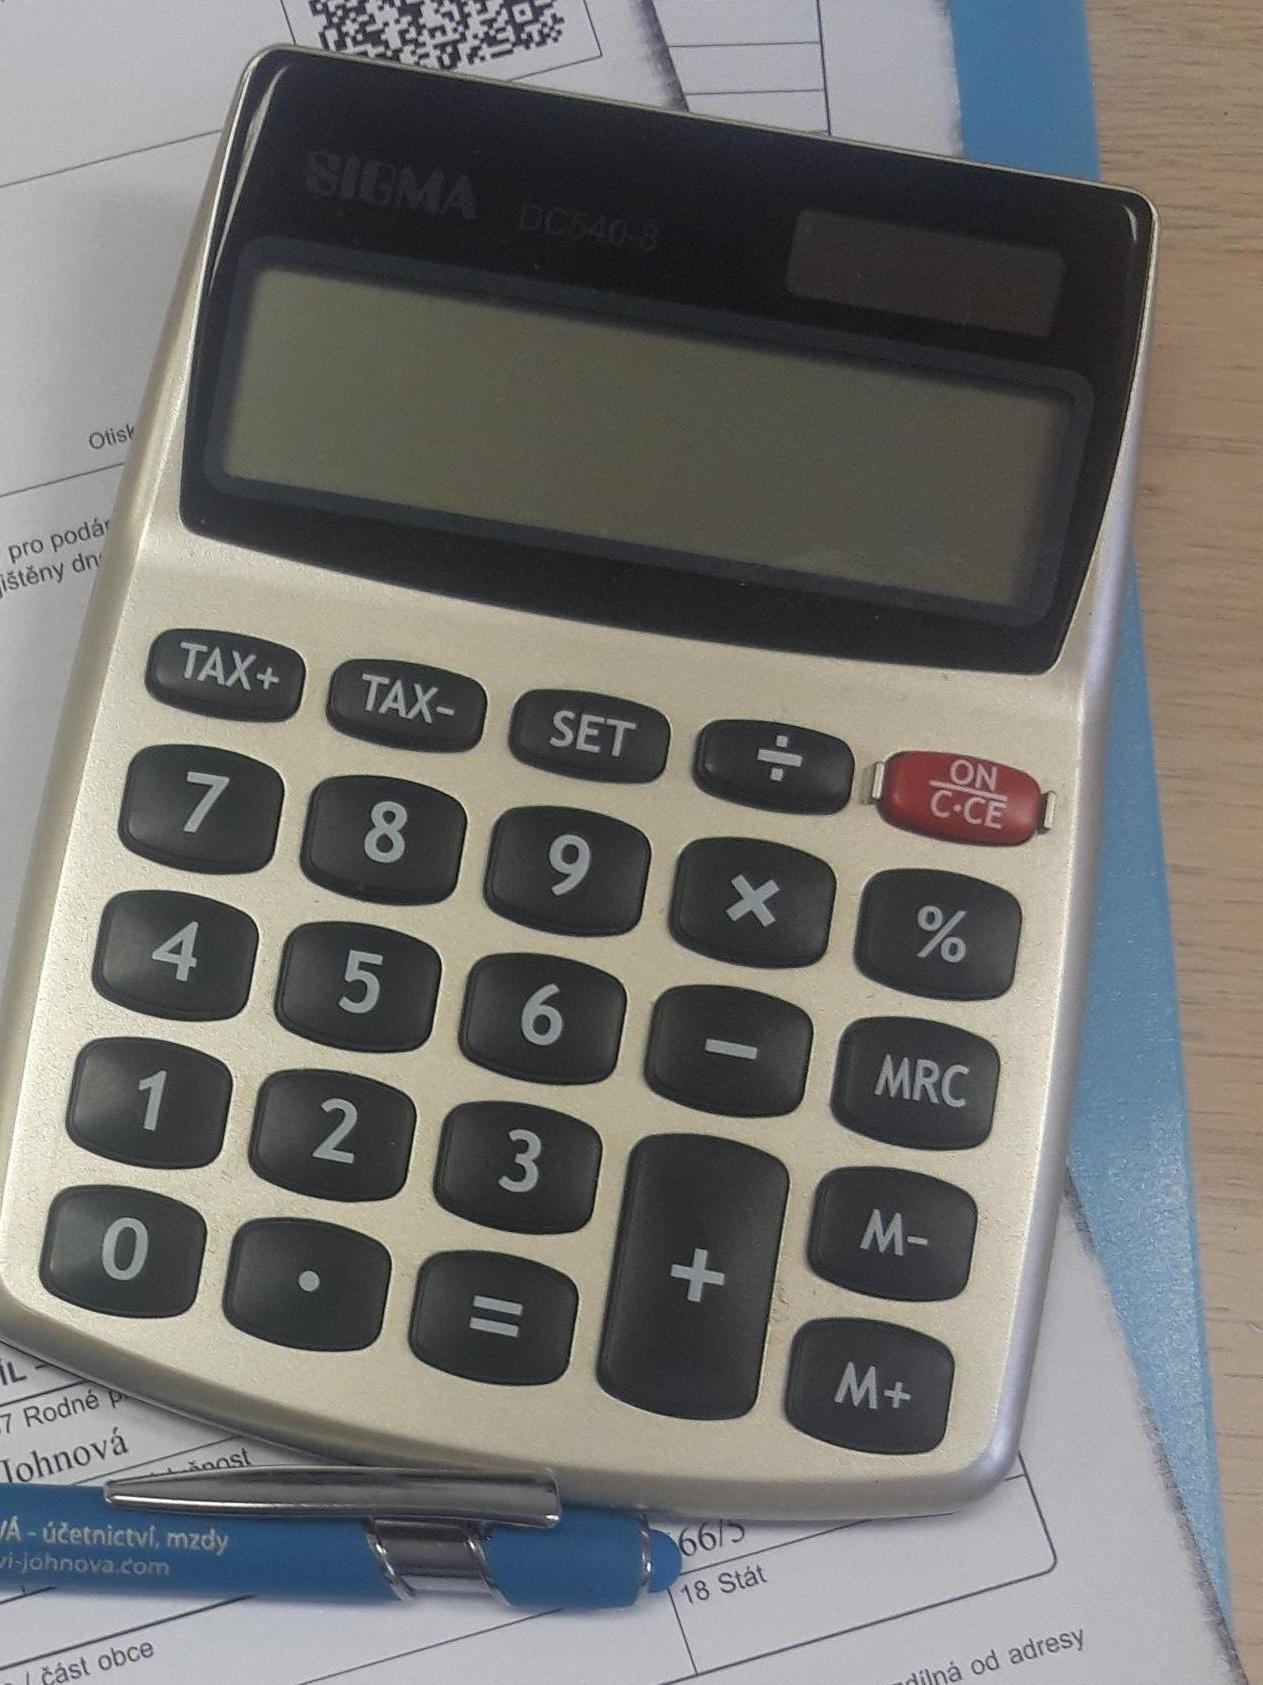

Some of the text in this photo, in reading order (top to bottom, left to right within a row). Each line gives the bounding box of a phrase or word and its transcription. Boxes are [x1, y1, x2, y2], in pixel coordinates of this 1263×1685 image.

[305, 148, 660, 252] SIGMA DC540-8
[89, 424, 135, 450] Otisk
[8, 538, 43, 563] pro
[72, 552, 102, 575] dn
[180, 641, 279, 691] TAX+
[362, 674, 455, 723] TAX-
[549, 710, 636, 758] SET
[184, 771, 230, 833] 7
[949, 759, 998, 791] ON
[364, 801, 408, 863] 8
[548, 834, 591, 896] 9
[152, 921, 198, 982] 4
[916, 905, 967, 963] %
[337, 950, 384, 1014] 5
[521, 983, 564, 1046] 6
[138, 1069, 168, 1131] 1
[874, 1054, 969, 1109] MRC
[312, 1098, 359, 1164] 2
[498, 1129, 542, 1193] 3
[102, 1217, 149, 1281] 0
[860, 1209, 928, 1256] M-
[23, 1389, 99, 1428] Rodné
[835, 1361, 911, 1410] M+
[0, 1427, 129, 1484] Johnová
[42, 1520, 160, 1550] účetnictví,
[165, 1531, 229, 1557] mzdy
[681, 1564, 767, 1604] 18 Stát
[41, 1656, 90, 1685] část
[98, 1640, 154, 1672] obce
[893, 1629, 1084, 1685] dílná od adresy
